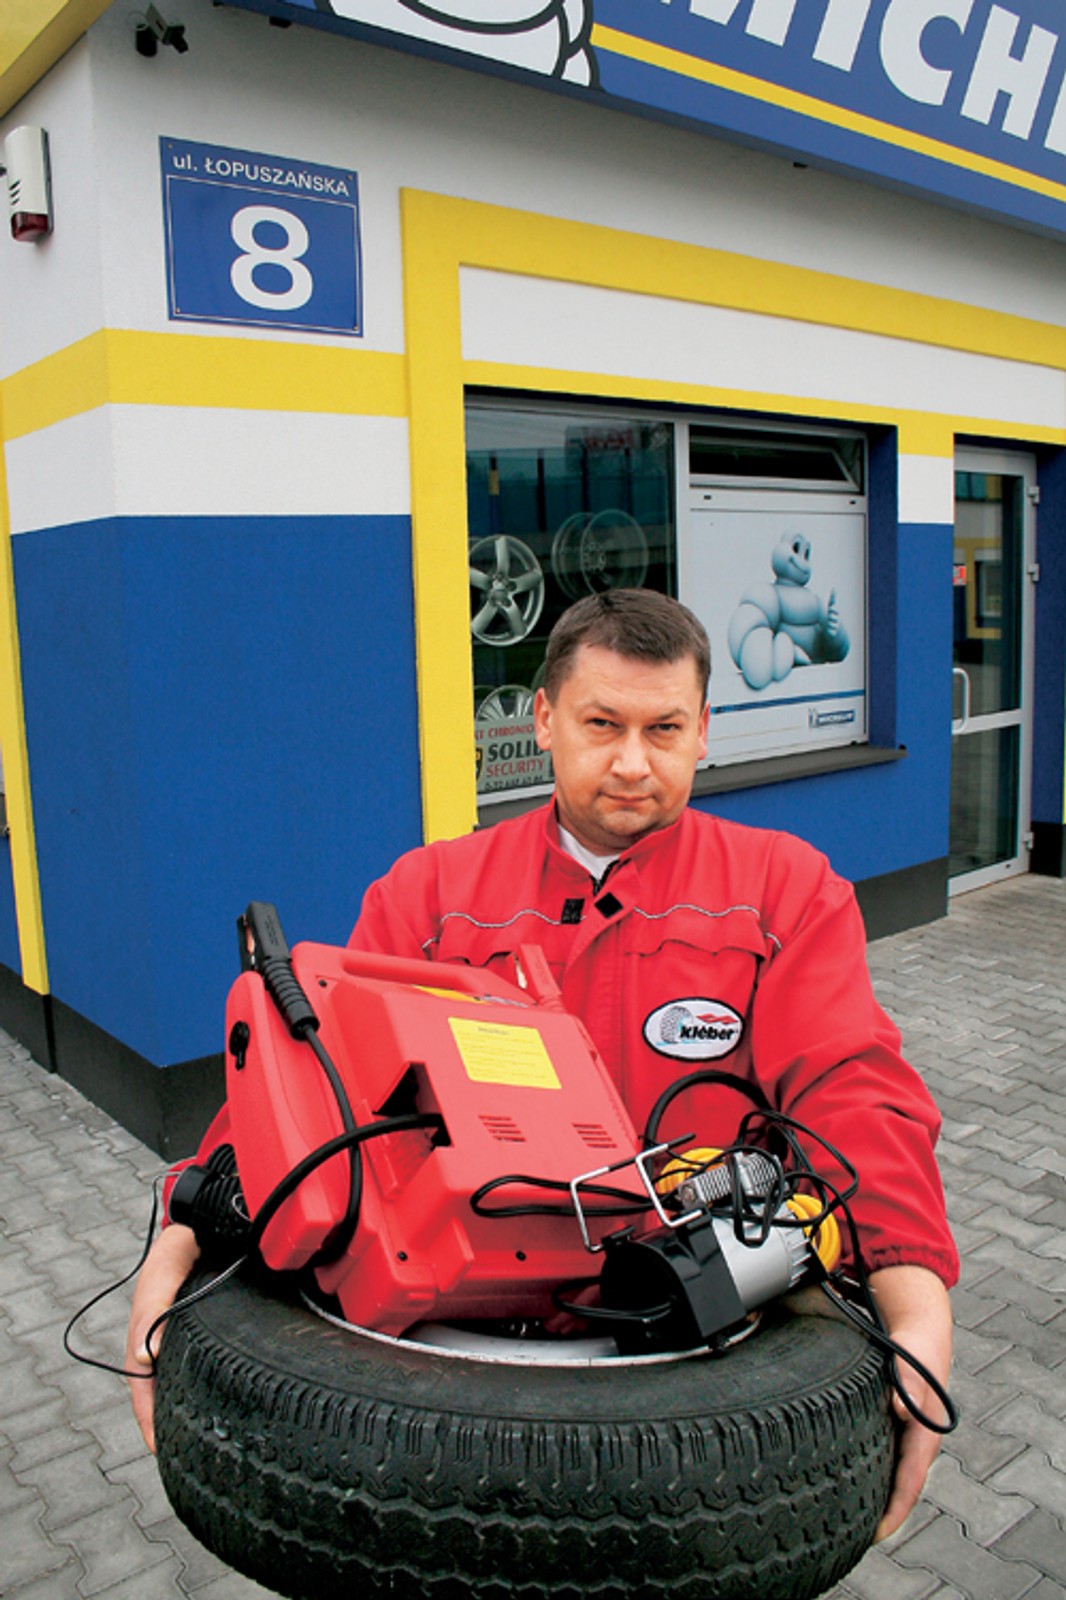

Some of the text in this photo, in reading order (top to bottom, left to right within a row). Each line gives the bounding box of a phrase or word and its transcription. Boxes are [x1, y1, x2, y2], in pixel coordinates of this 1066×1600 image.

[660, 0, 1066, 156] ICH
[173, 154, 350, 197] ul. ŁOPUSZAŃSKA
[230, 205, 313, 311] 8
[486, 757, 544, 778] SECURITY
